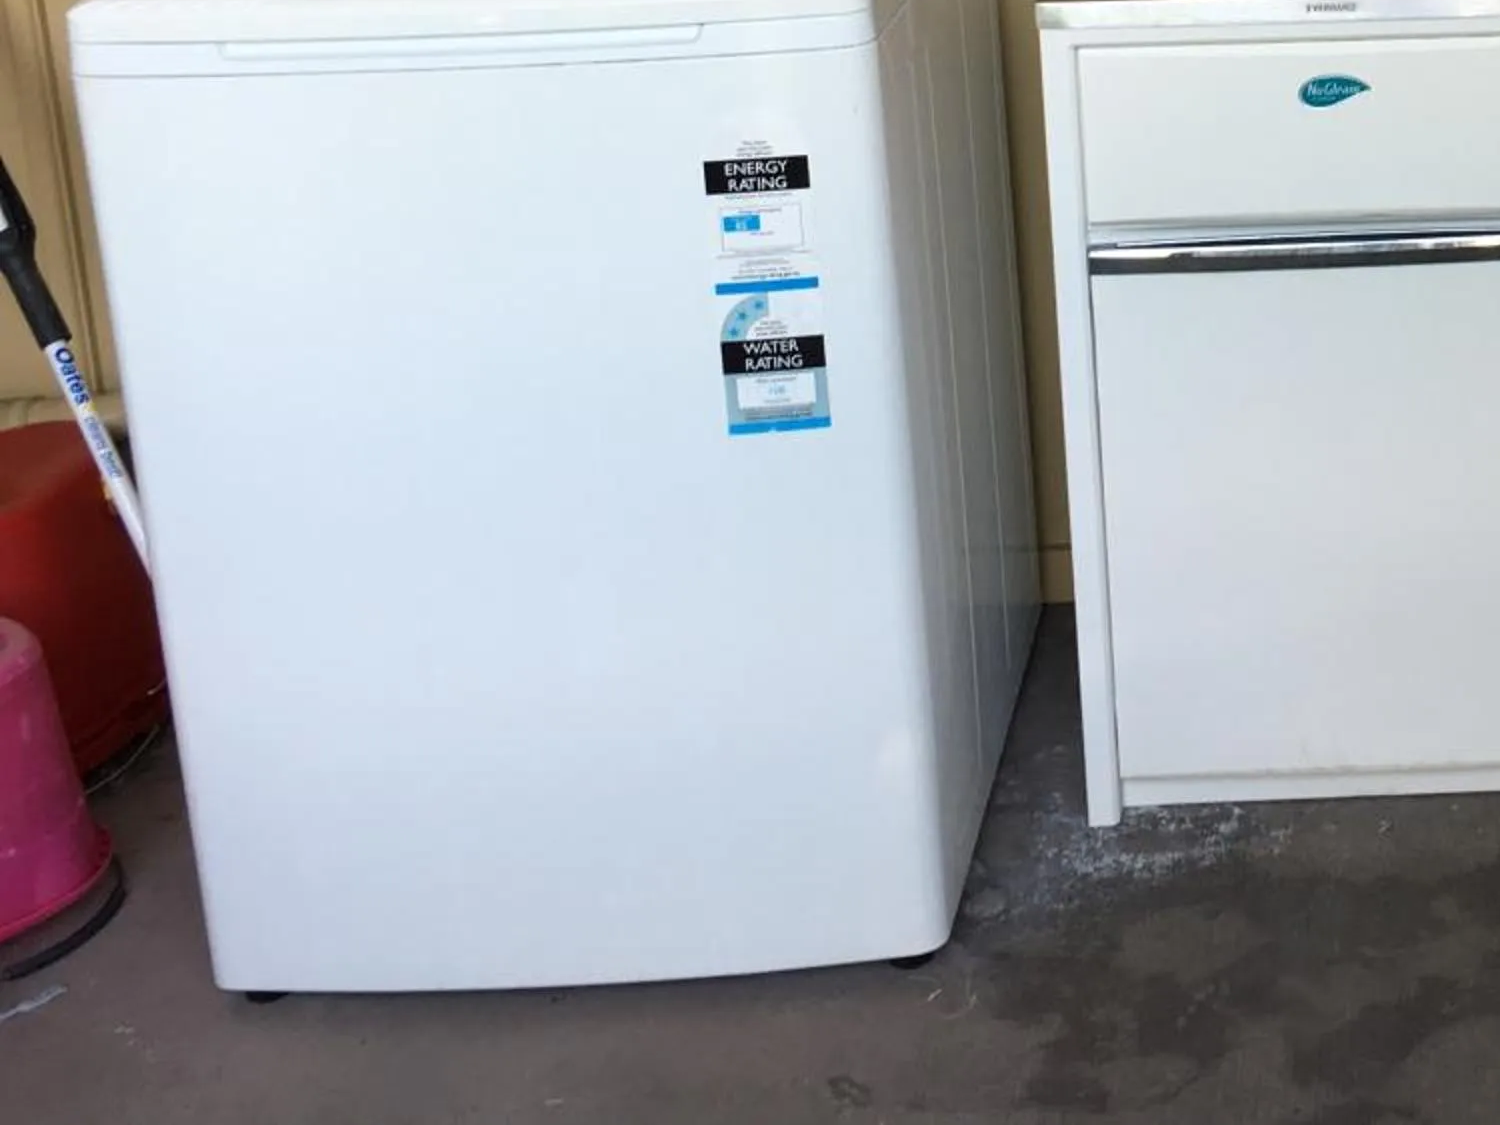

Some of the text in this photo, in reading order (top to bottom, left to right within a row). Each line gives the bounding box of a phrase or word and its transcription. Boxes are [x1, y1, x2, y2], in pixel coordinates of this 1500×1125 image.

[724, 159, 788, 176] ENERGY
[727, 175, 788, 192] RATING
[743, 338, 800, 355] WATER
[745, 354, 804, 372] RATING
